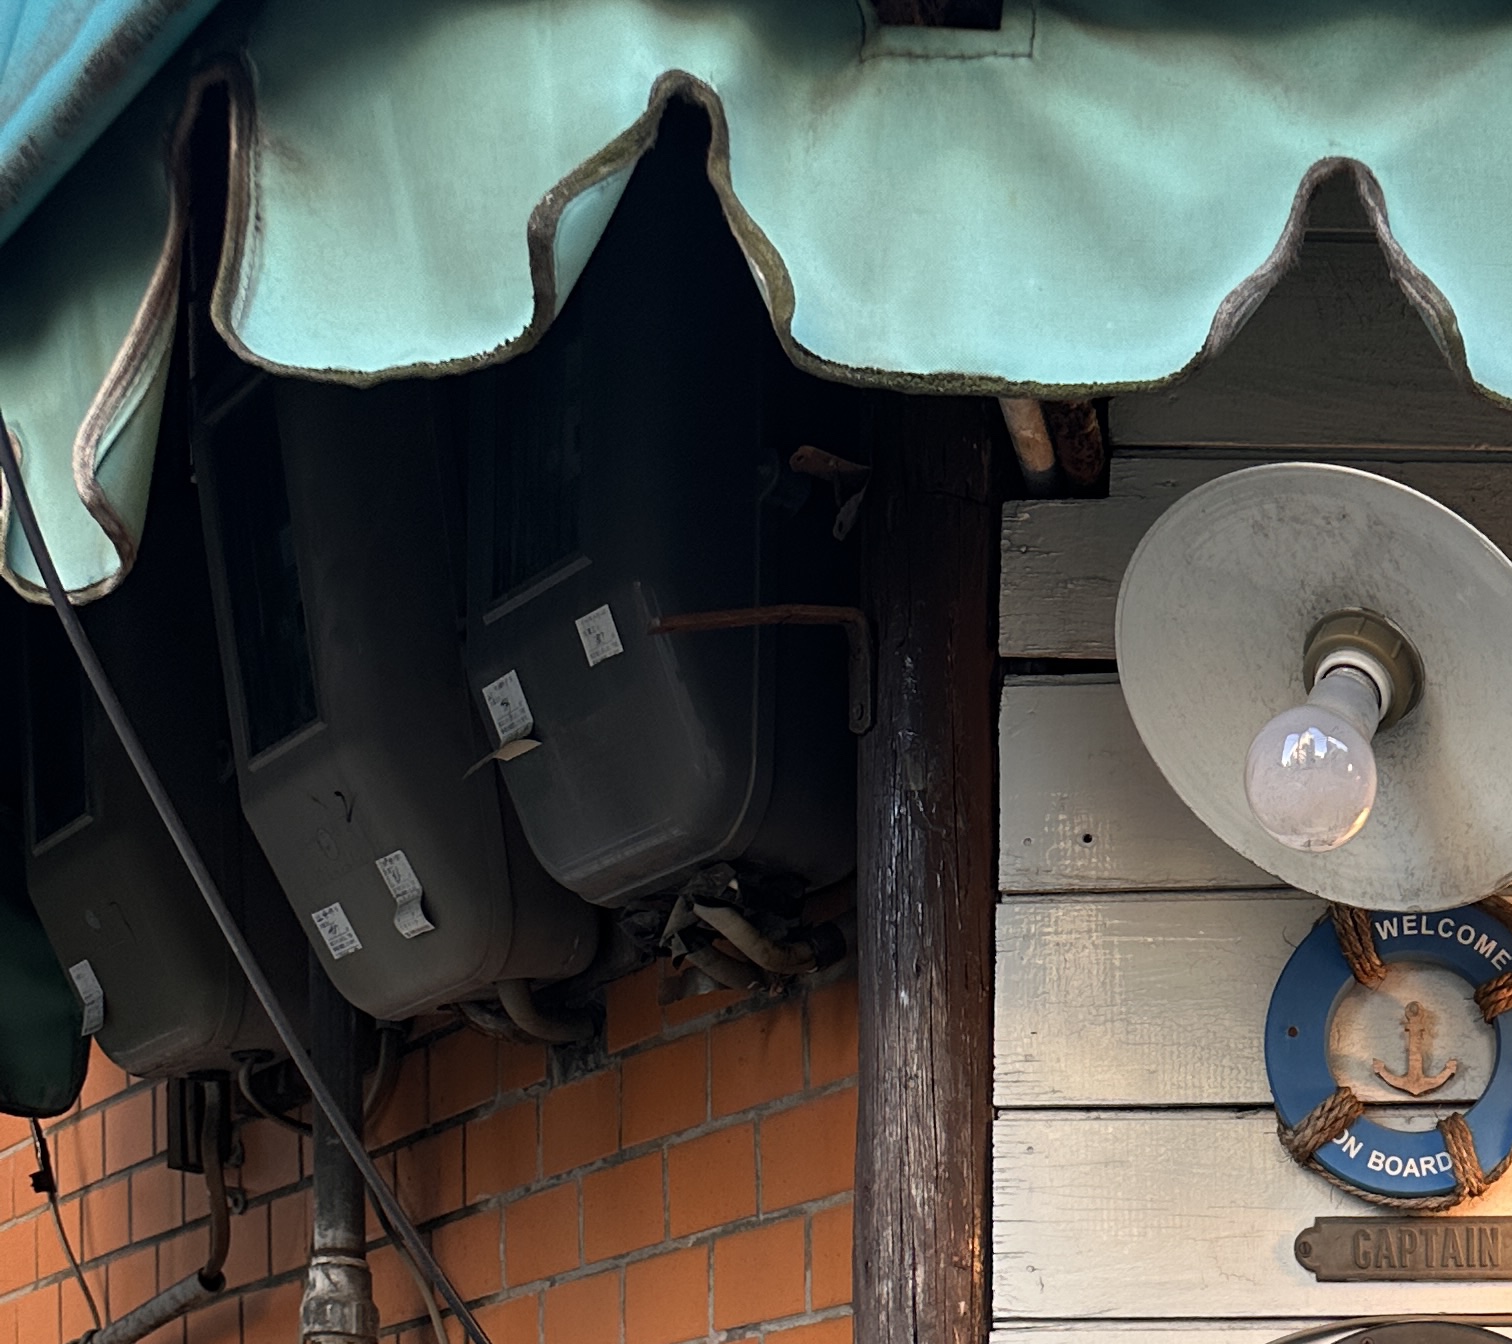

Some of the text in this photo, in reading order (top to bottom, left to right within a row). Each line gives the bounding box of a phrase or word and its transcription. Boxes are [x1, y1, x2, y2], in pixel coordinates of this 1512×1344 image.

[1375, 914, 1512, 970] WELCOME
[1367, 1149, 1454, 1178] BOARD
[1353, 1226, 1503, 1271] CAPTAIN
